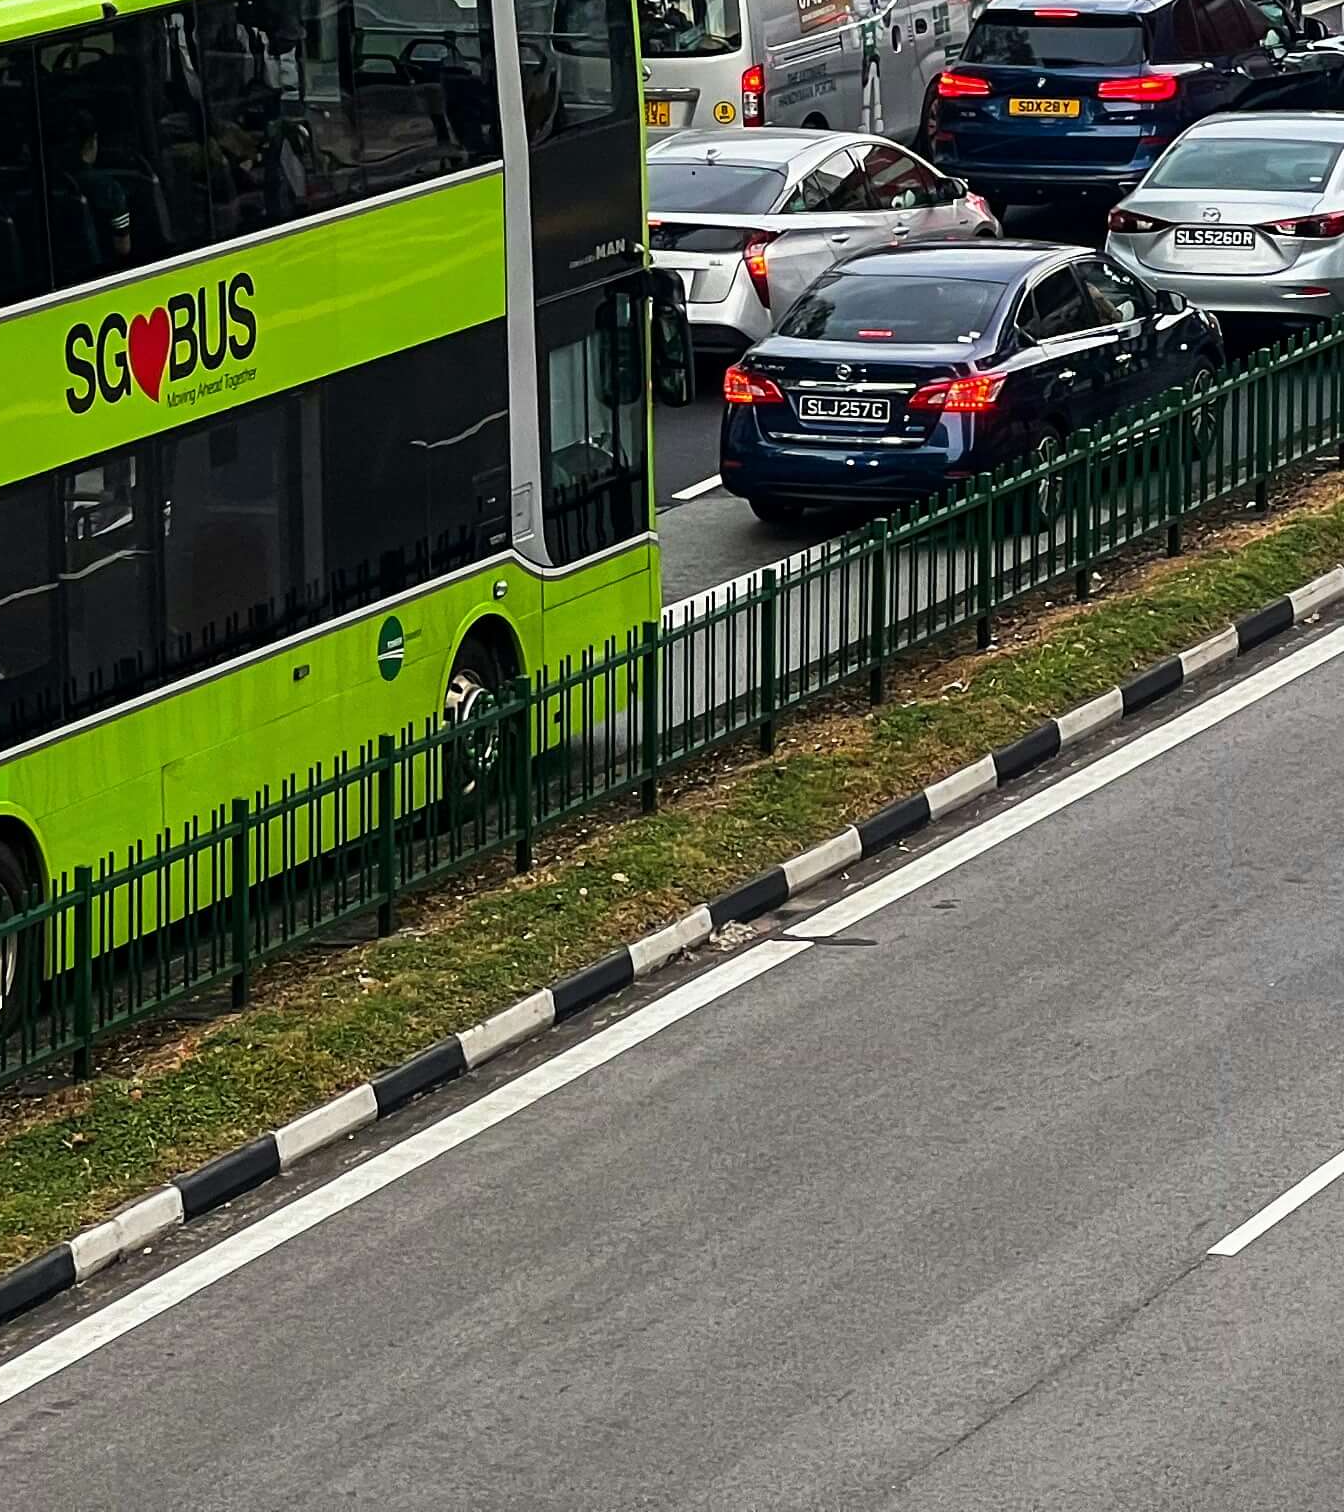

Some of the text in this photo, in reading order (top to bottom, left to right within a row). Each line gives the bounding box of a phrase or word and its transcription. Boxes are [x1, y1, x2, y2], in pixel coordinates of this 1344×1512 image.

[596, 239, 626, 260] MAN
[167, 368, 257, 408] Moving Ahead Together
[807, 399, 883, 418] SLJ257G
